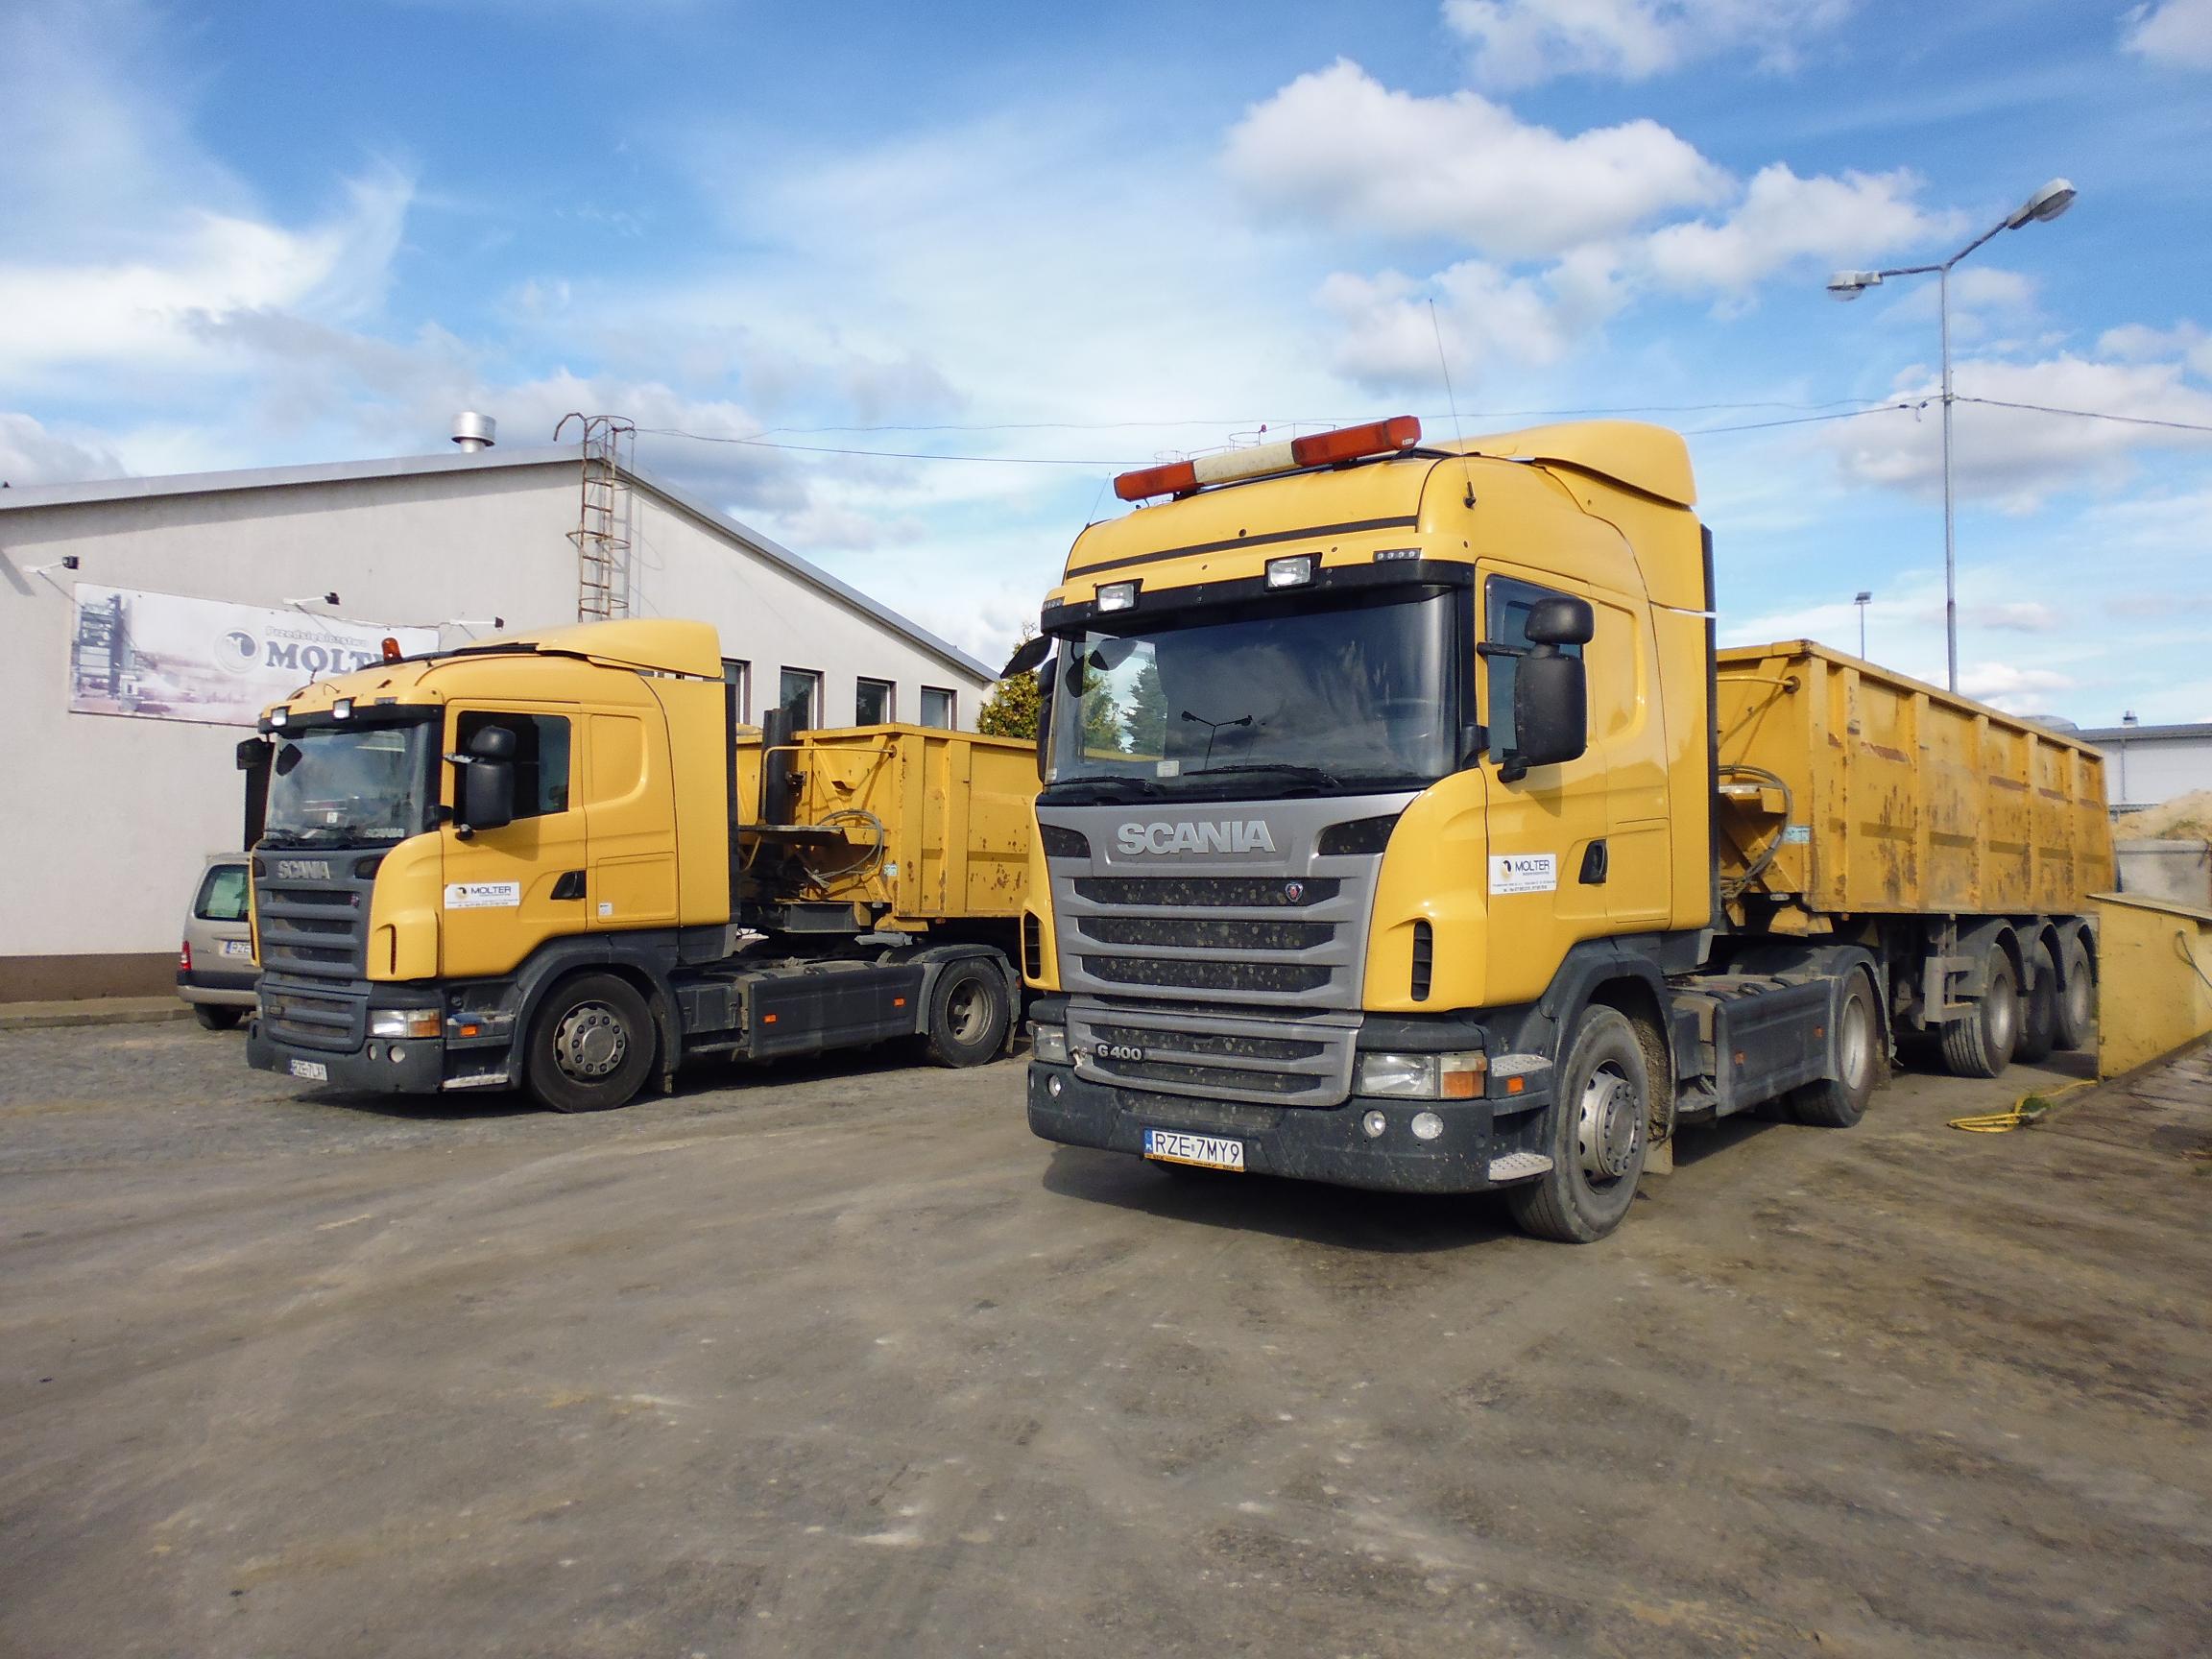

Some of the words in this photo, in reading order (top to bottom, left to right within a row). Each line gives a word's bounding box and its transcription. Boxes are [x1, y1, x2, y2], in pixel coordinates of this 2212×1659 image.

[1117, 820, 1277, 855] SCANIA
[277, 860, 330, 879] SCANIA
[1515, 859, 1551, 872] MOLTER
[470, 885, 512, 895] MOLTER
[1097, 1044, 1109, 1057] G
[1110, 1046, 1142, 1061] 400
[1196, 1139, 1239, 1164] 7MY9
